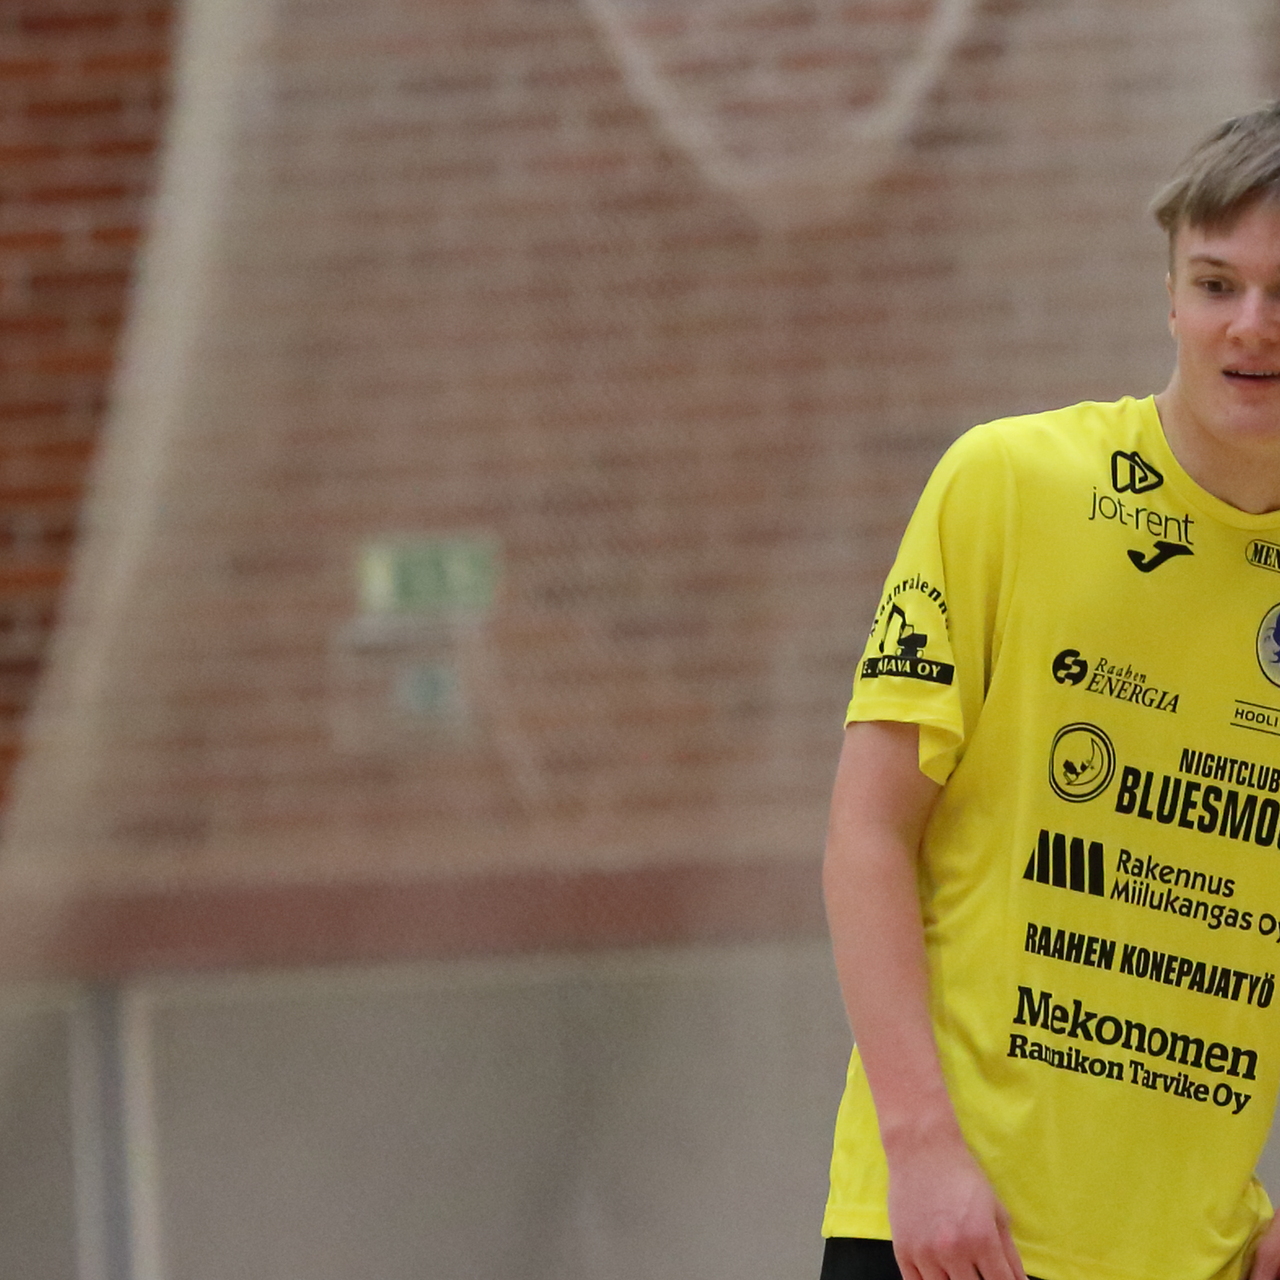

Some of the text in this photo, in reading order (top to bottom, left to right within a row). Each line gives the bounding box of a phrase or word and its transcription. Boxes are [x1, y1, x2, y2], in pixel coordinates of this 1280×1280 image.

[1088, 486, 1195, 545] jot-rent
[917, 662, 941, 678] OY
[1085, 672, 1180, 714] ENERGIA
[1095, 657, 1147, 683] Raahen
[1234, 708, 1279, 728] HOOLI
[1116, 849, 1235, 897] Rakennus
[1110, 878, 1253, 931] Miilukangas
[1024, 922, 1276, 1008] RAAHEN KONEPAJATYÖ
[1013, 985, 1258, 1081] Mekonomen
[1129, 1060, 1210, 1102] Tarvike
[1212, 1083, 1252, 1115] Oy
